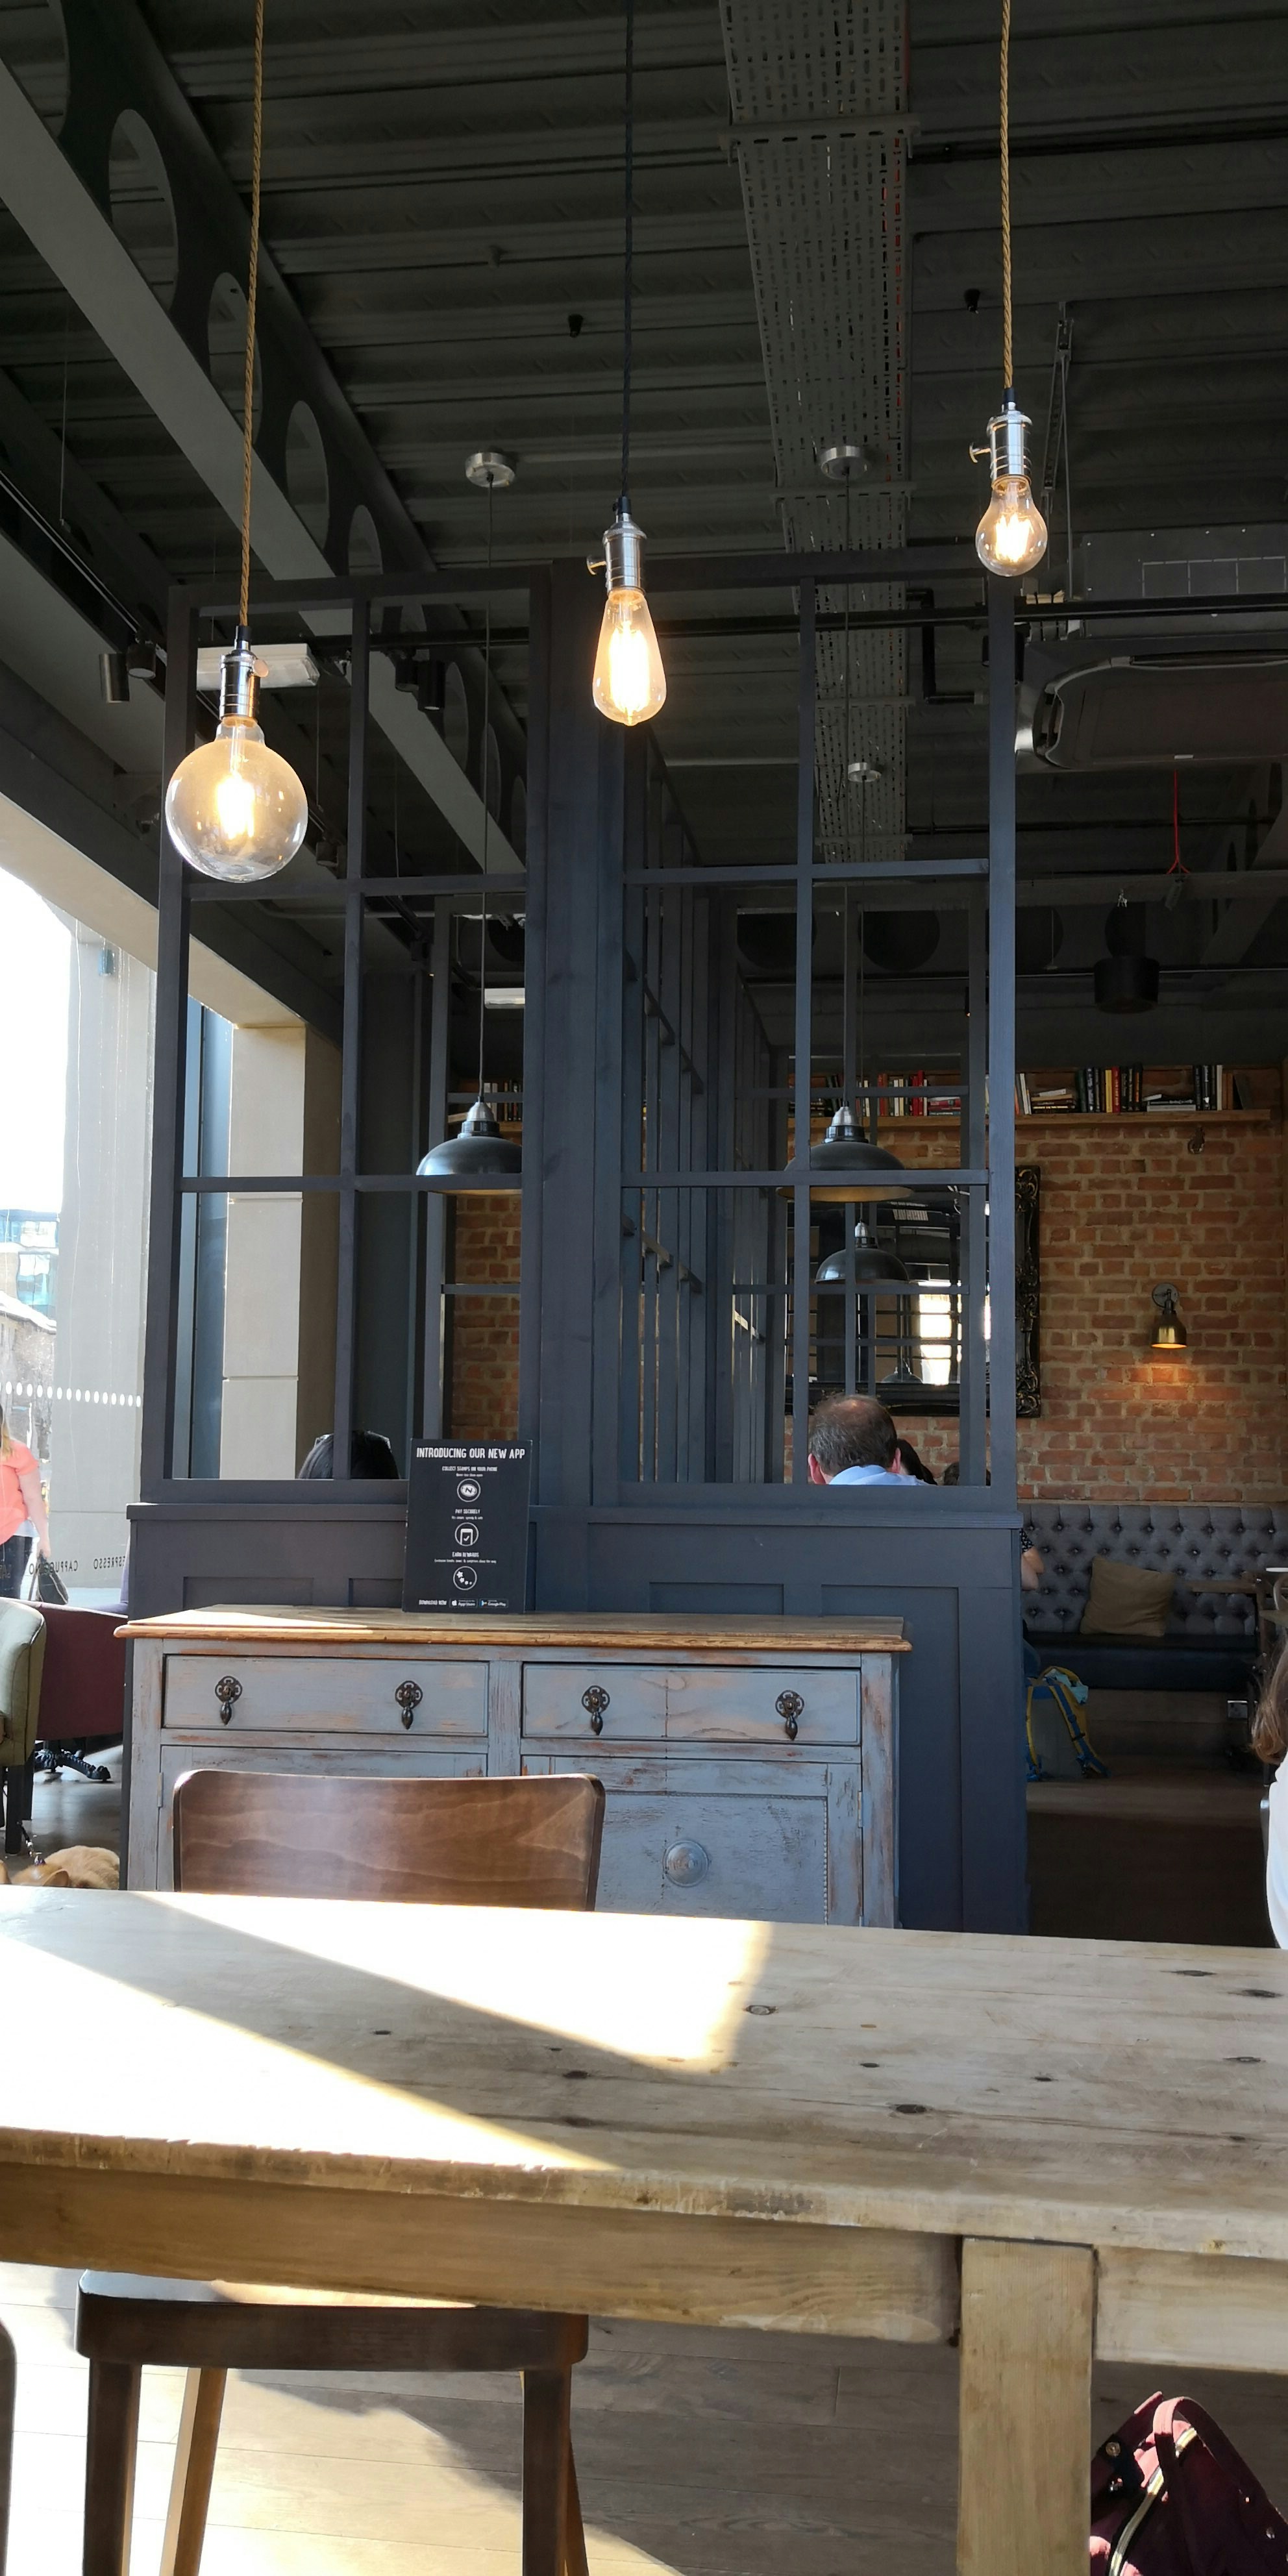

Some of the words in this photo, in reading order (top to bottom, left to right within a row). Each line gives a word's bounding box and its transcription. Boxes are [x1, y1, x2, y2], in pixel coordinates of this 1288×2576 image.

[416, 1447, 467, 1458] INTRODUCING
[469, 1448, 486, 1459] OUR
[488, 1448, 507, 1459] NEW
[509, 1448, 525, 1459] APP
